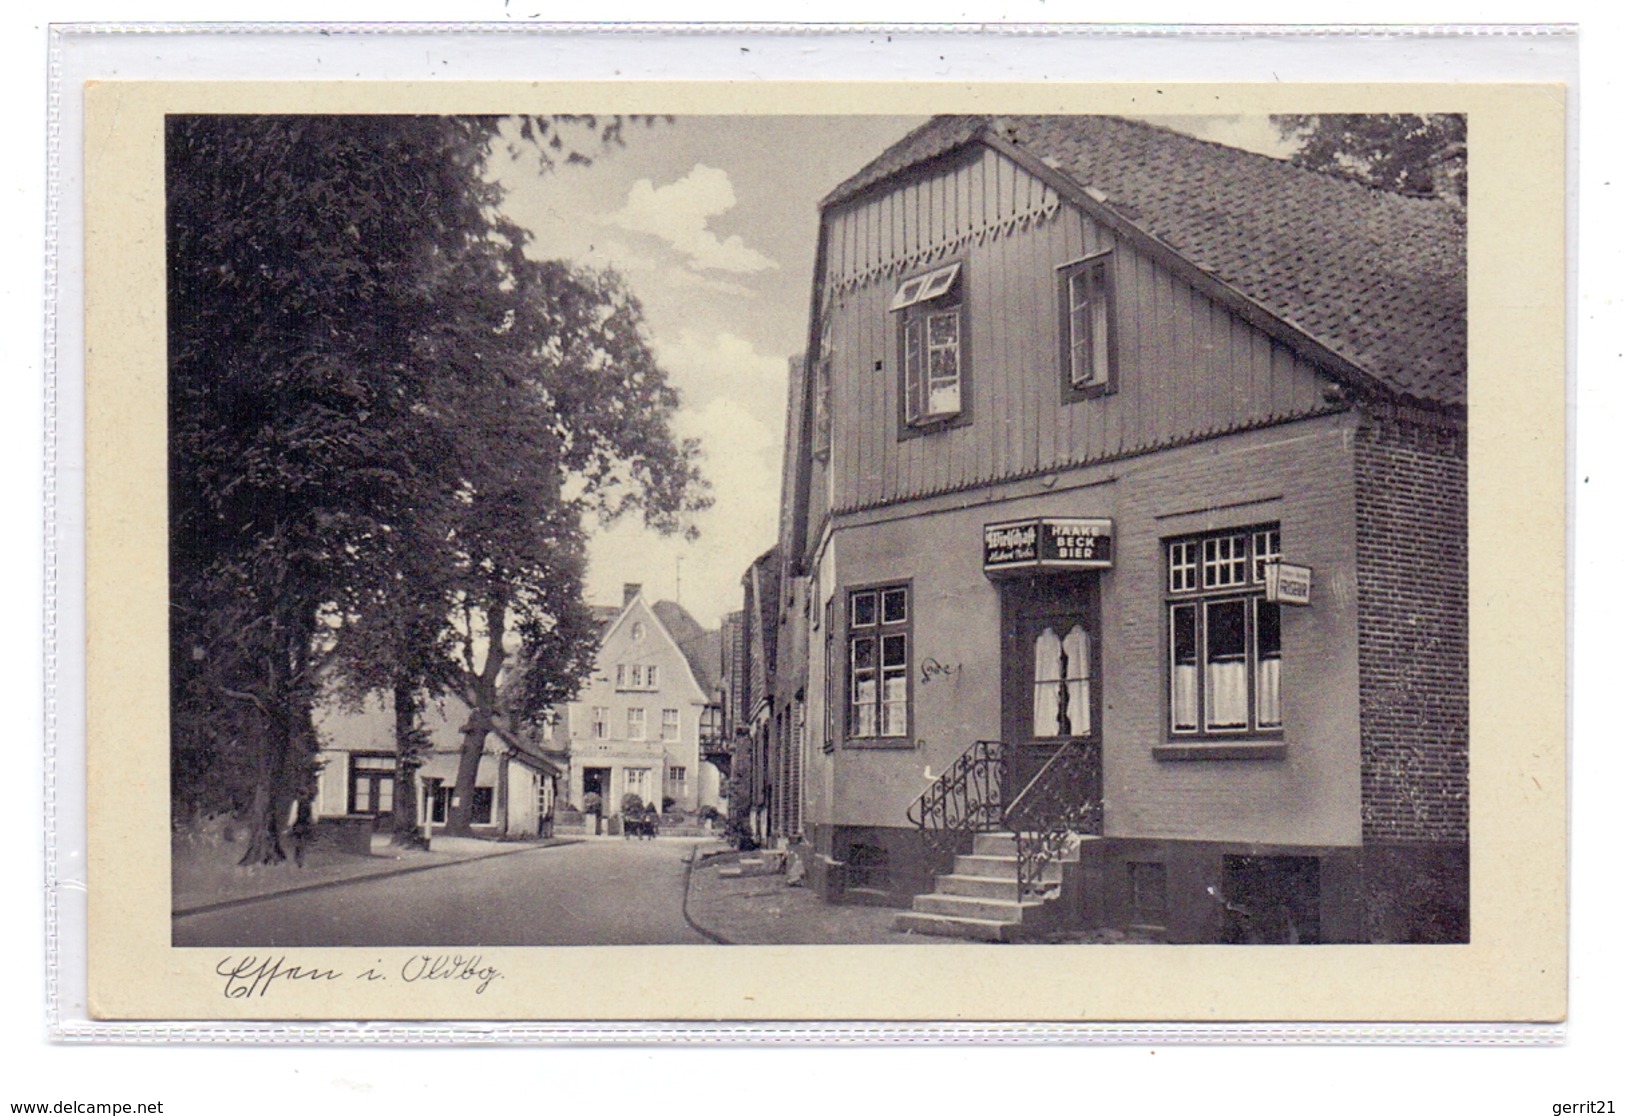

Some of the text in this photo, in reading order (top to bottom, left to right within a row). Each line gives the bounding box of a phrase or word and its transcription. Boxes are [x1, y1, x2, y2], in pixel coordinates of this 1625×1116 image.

[1050, 526, 1100, 536] HAAKE
[1056, 537, 1095, 547] BECK
[1059, 547, 1093, 558] BIER
[216, 956, 343, 998] Essen
[357, 959, 386, 980] i.
